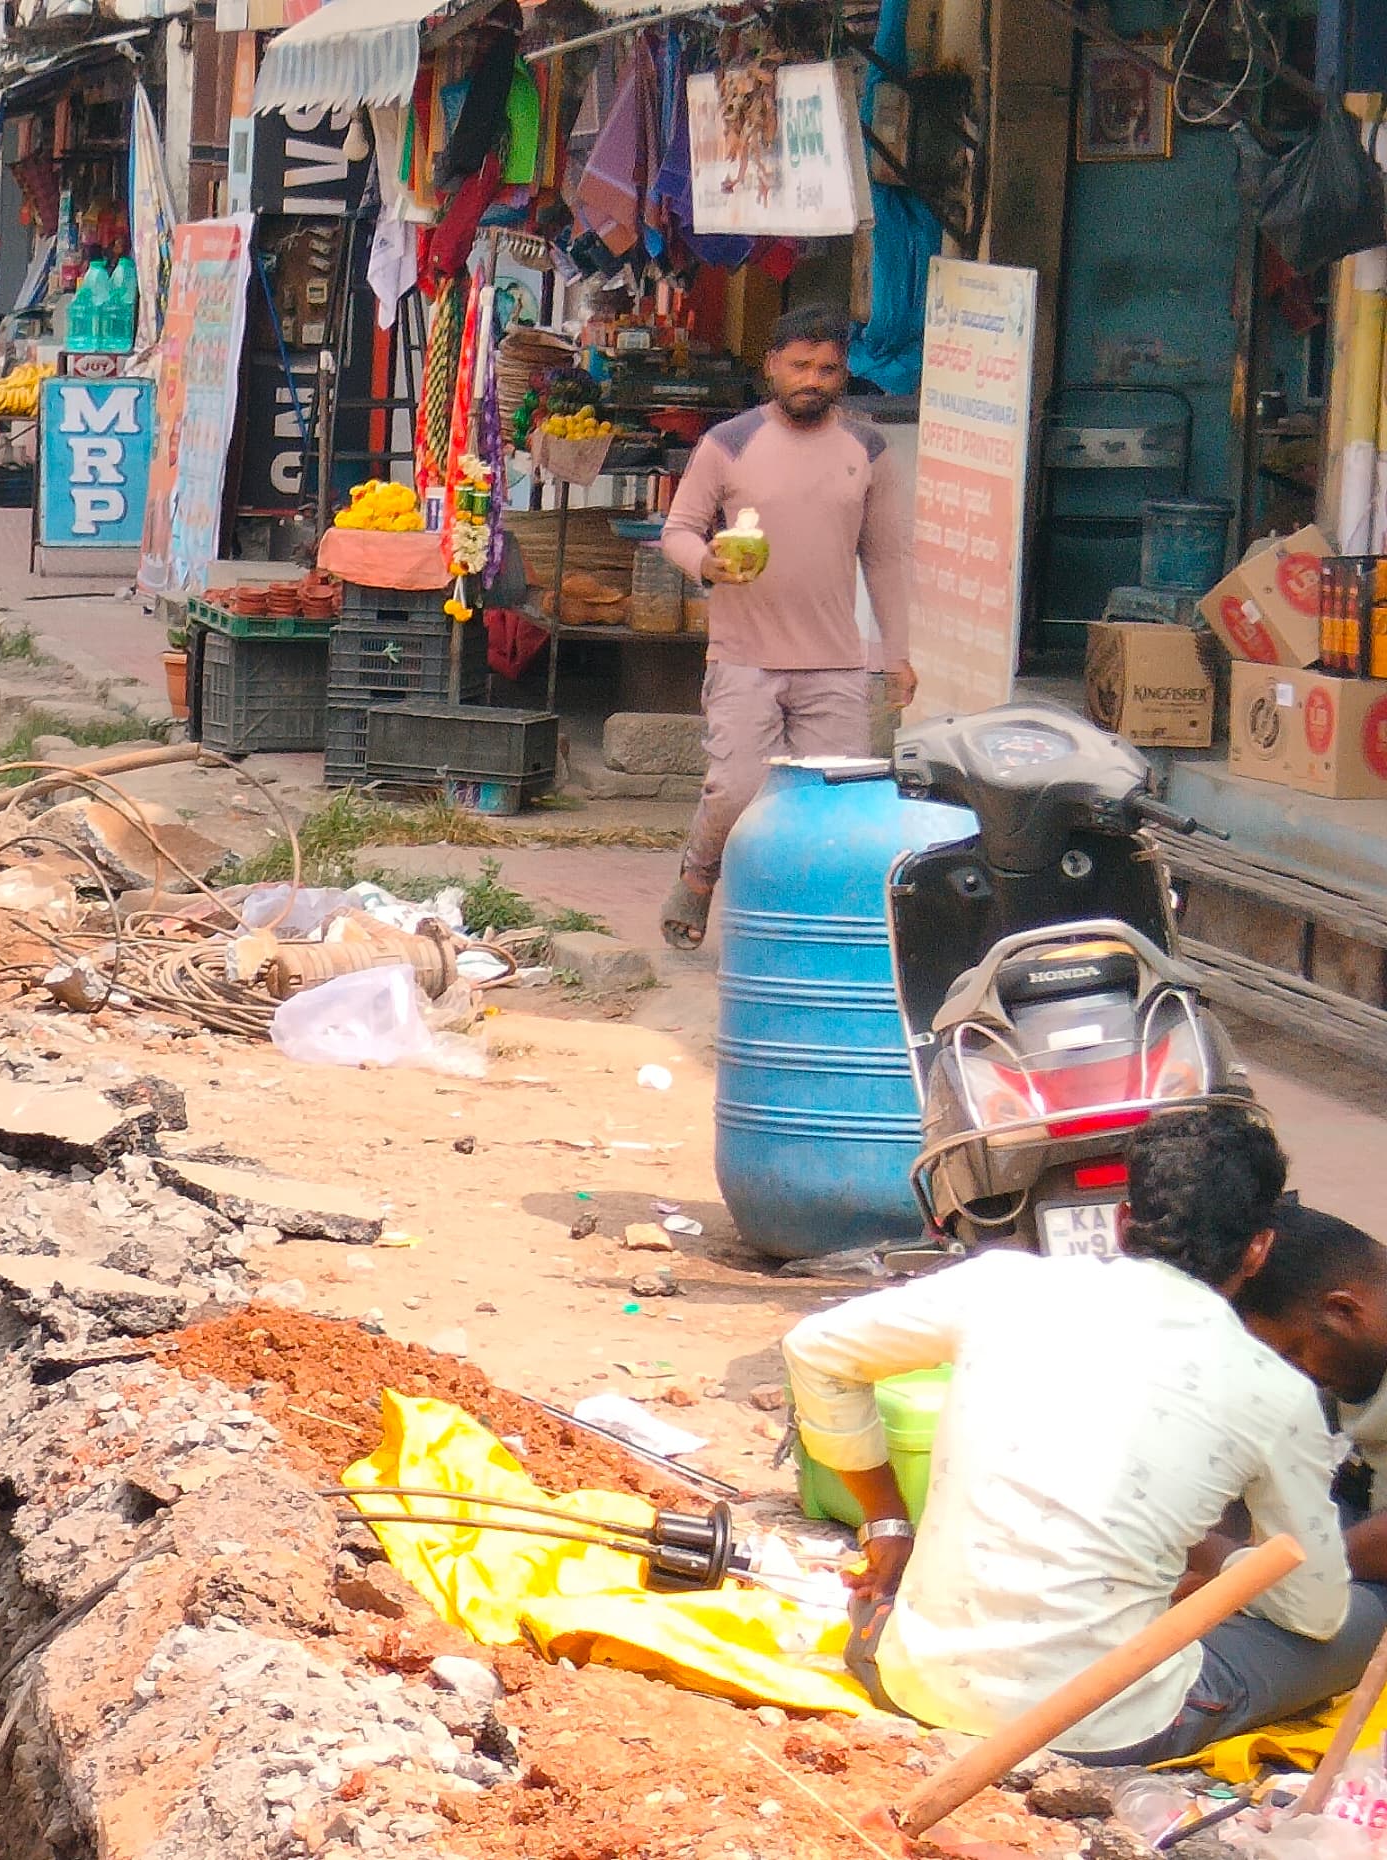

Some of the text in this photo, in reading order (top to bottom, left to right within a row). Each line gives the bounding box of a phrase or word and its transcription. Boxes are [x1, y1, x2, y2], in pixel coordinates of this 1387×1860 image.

[59, 386, 141, 535] MRP
[1027, 966, 1101, 983] HONDA
[1070, 1206, 1108, 1231] KA
